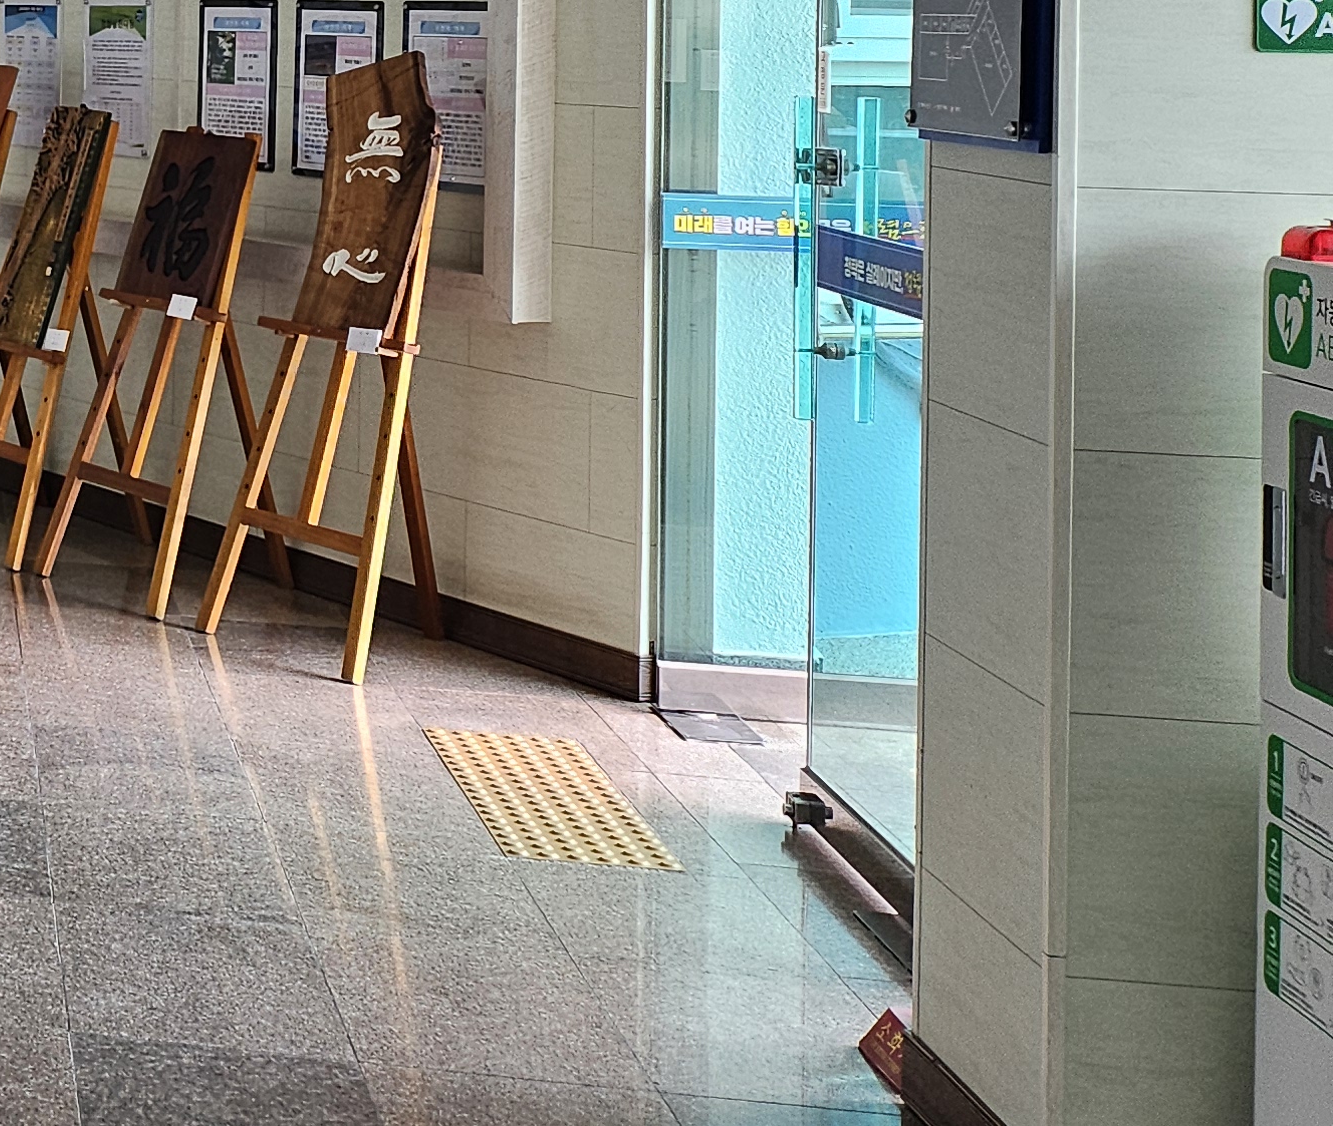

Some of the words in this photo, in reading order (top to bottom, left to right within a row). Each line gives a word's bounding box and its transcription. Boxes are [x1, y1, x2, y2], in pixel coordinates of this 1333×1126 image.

[674, 210, 732, 235] 미래를
[734, 216, 776, 236] 여는
[1271, 838, 1279, 861] 2
[1269, 926, 1277, 948] 3
[876, 1021, 904, 1058] 소화
